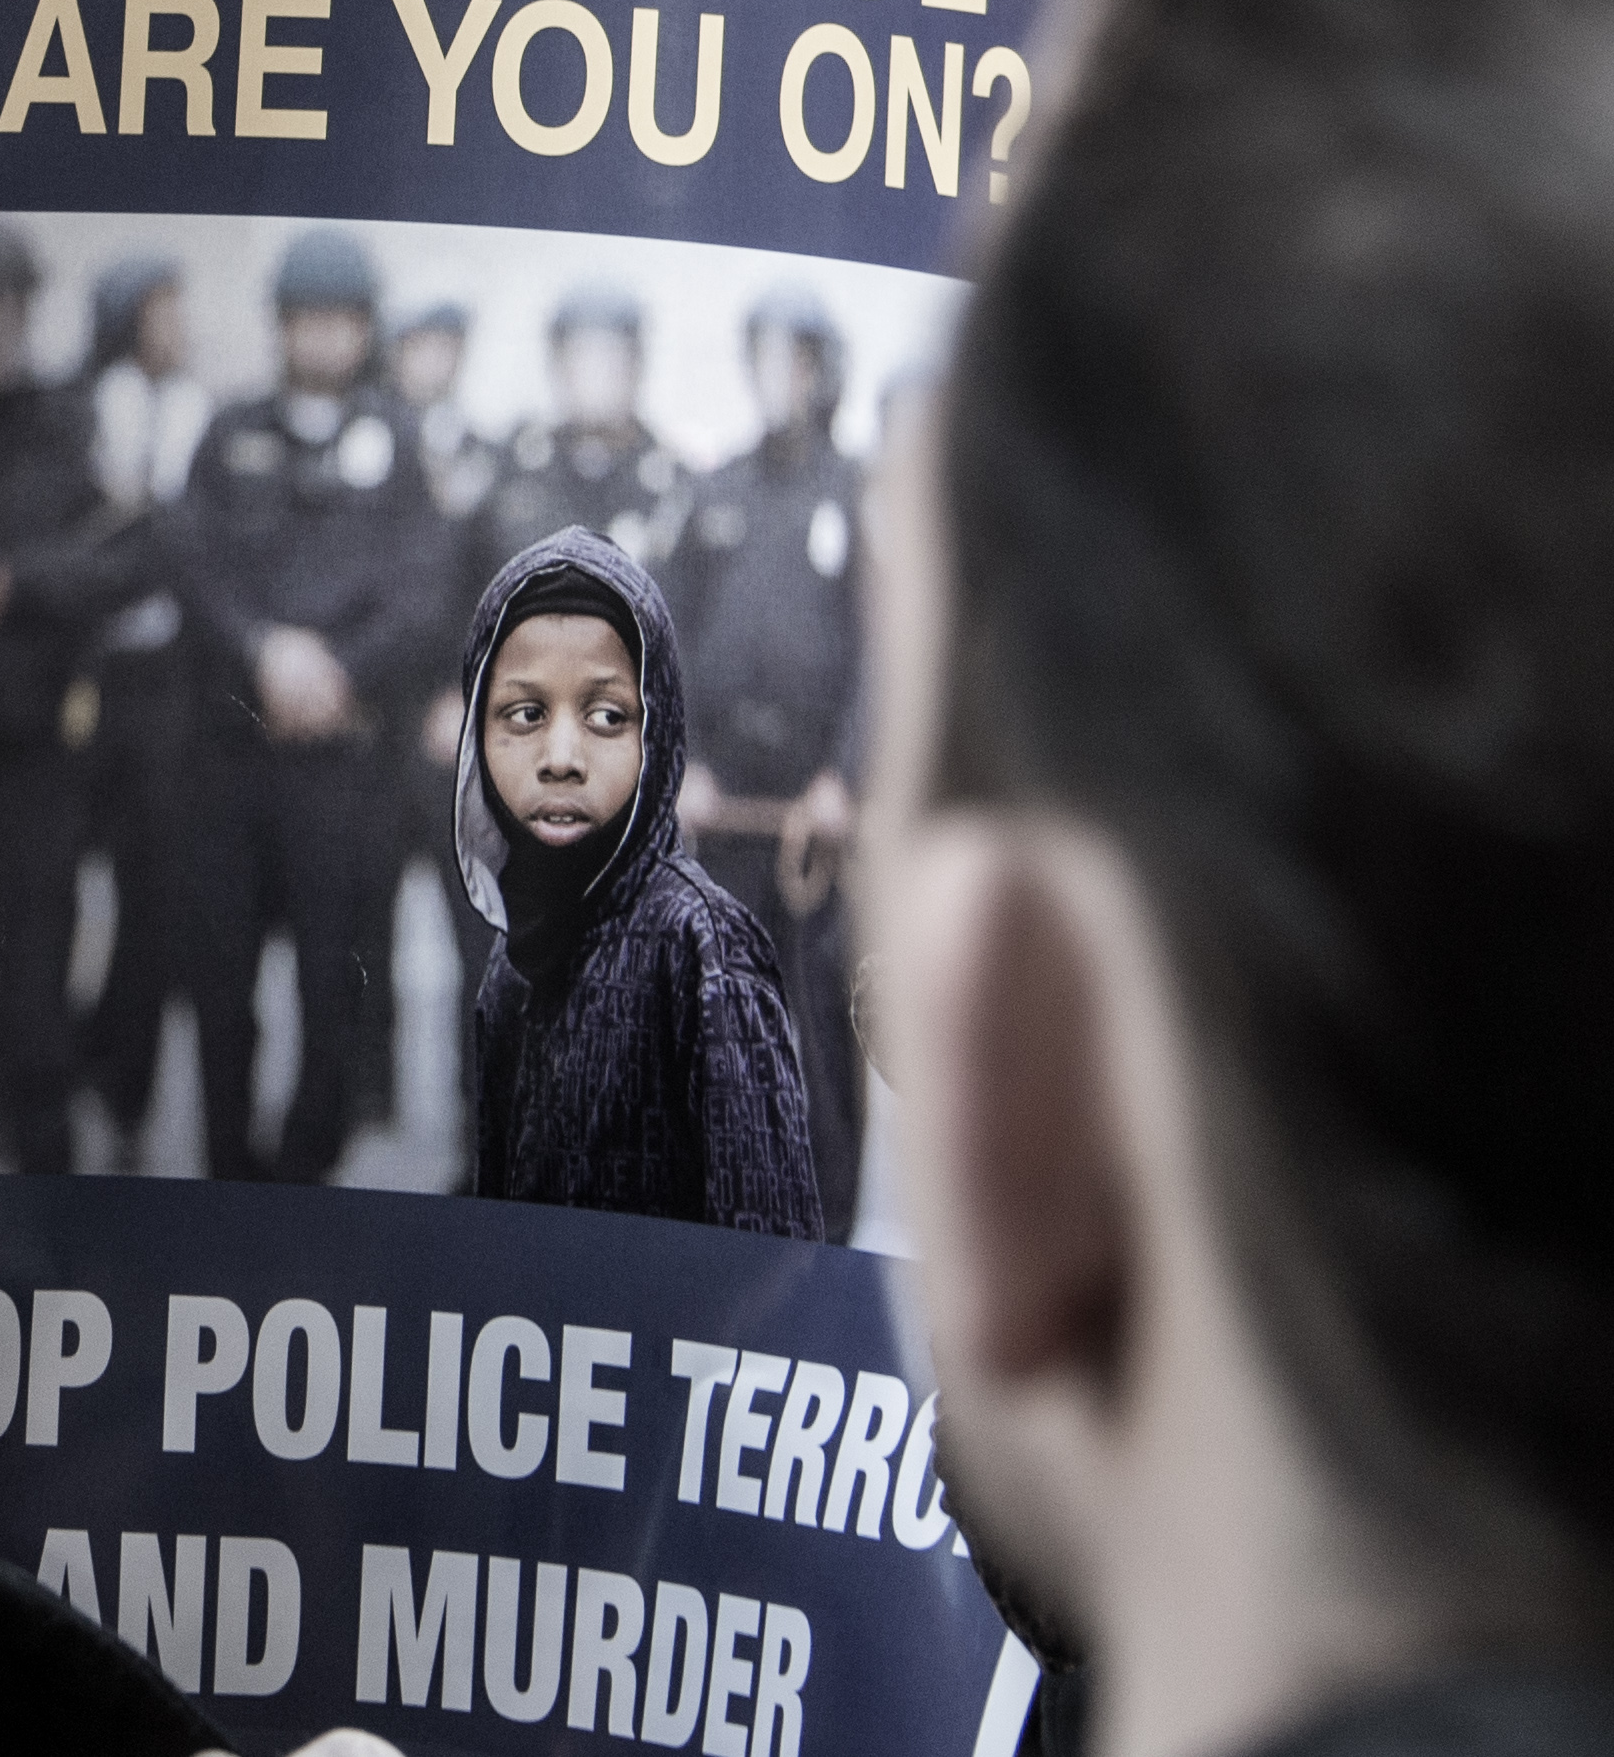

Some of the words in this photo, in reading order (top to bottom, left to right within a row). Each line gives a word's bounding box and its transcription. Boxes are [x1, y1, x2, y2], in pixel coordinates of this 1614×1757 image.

[780, 22, 1031, 205] ON?
[162, 1294, 632, 1491] POLICE
[671, 1338, 971, 1559] TERRO
[36, 1528, 301, 1697] AND
[355, 1543, 812, 1757] MURDER
